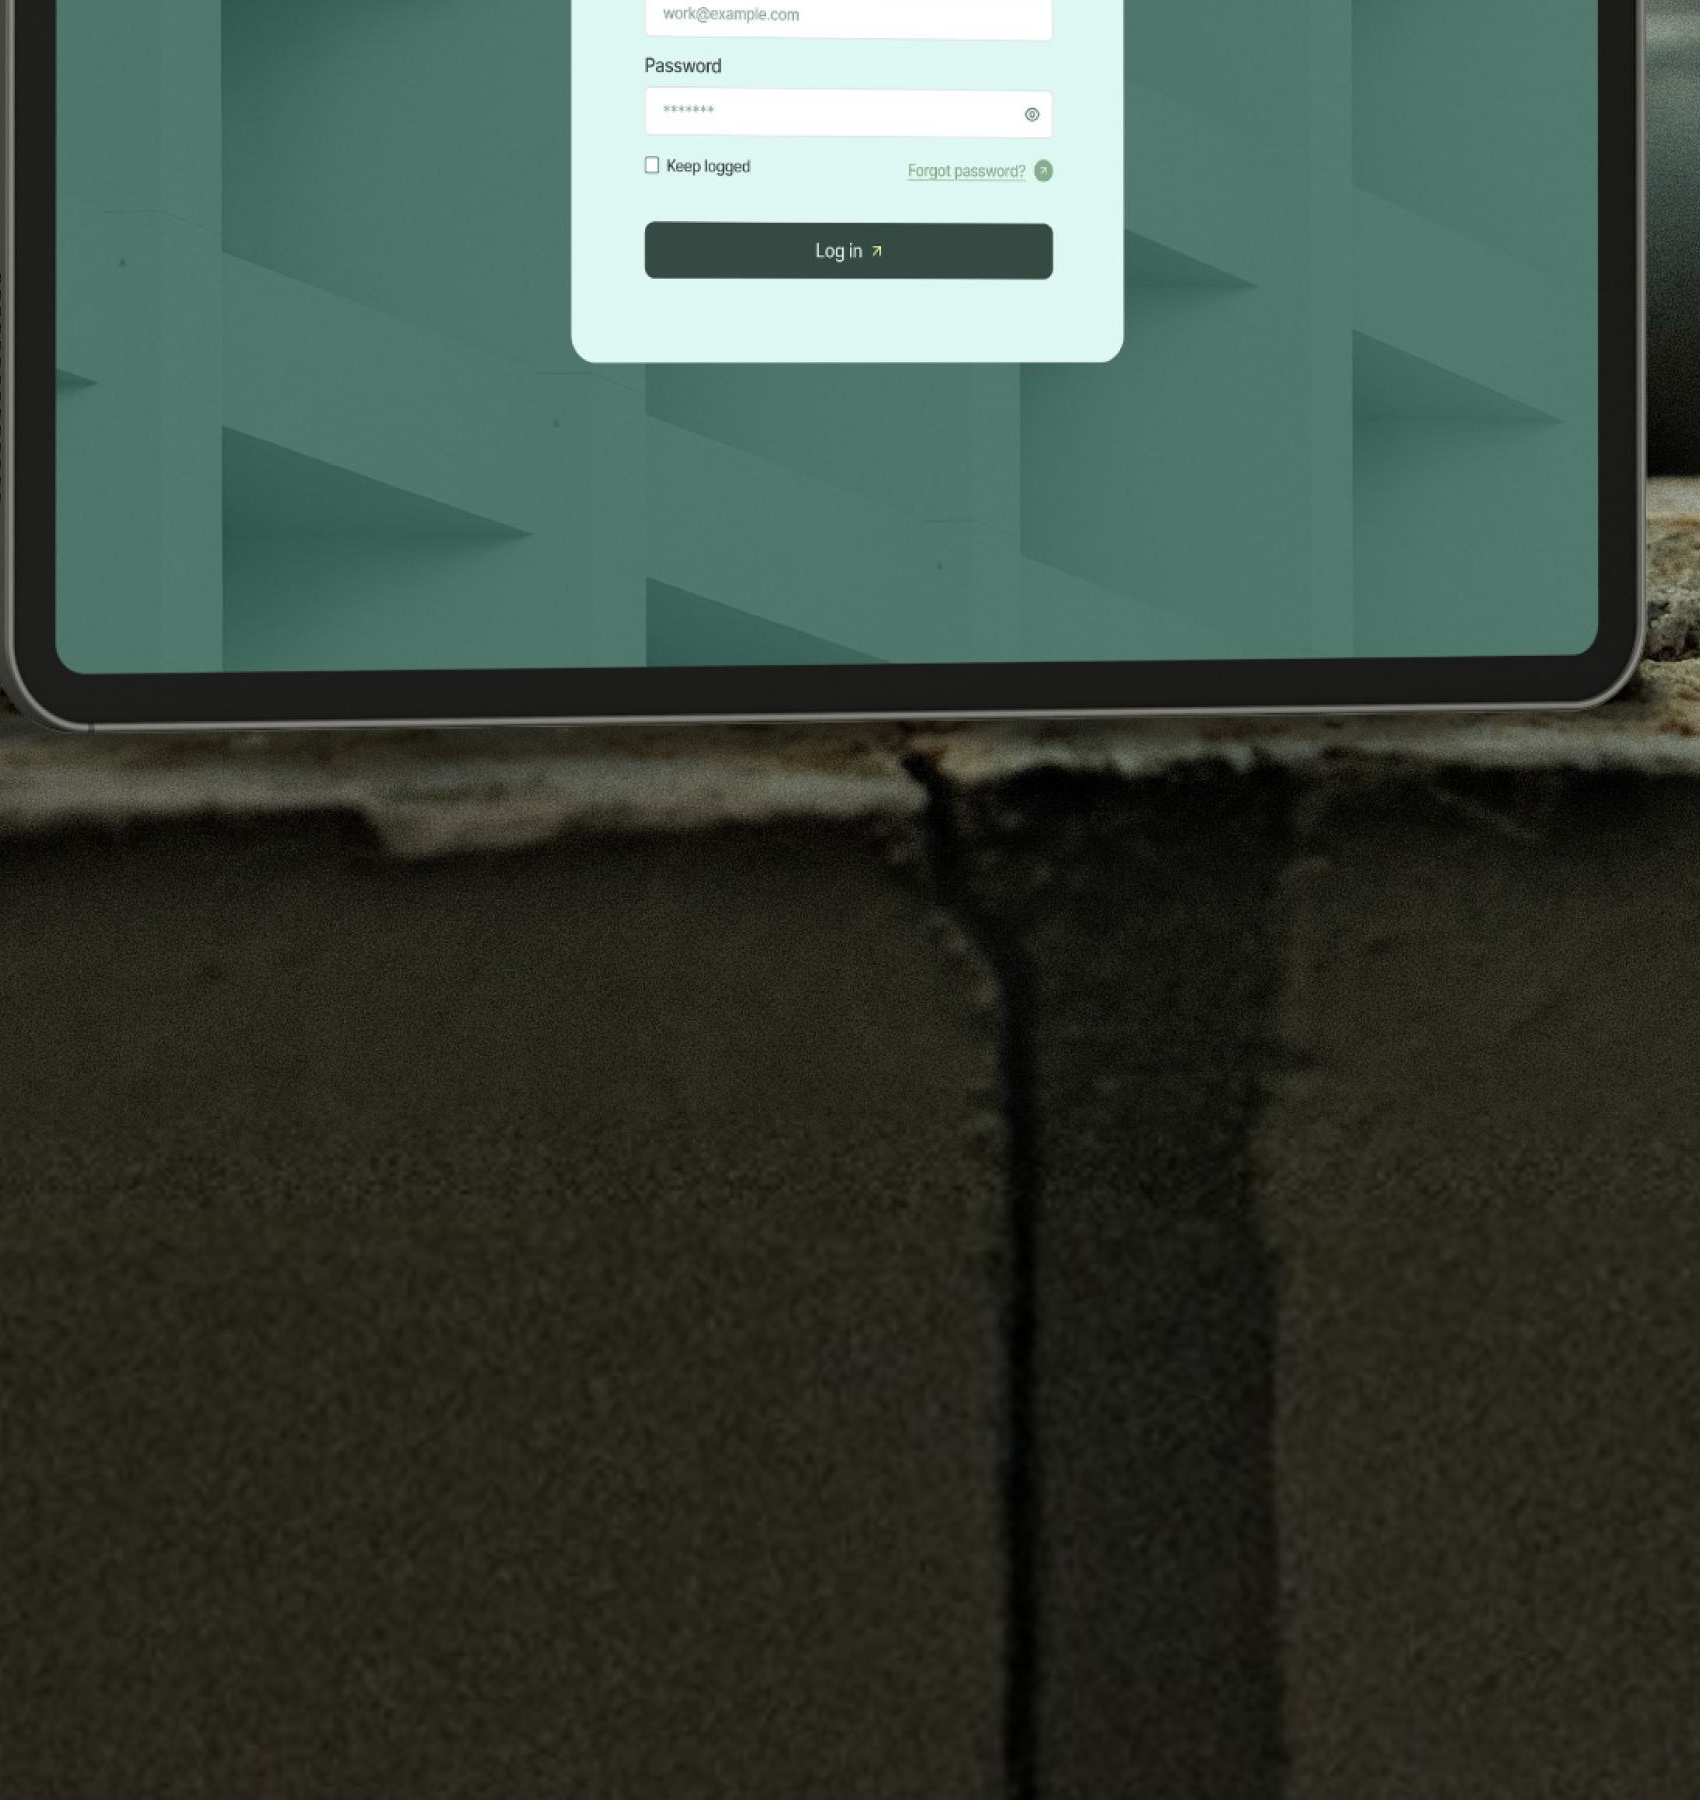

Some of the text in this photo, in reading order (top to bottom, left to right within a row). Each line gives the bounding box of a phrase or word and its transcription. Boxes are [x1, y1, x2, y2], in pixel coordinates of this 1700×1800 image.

[662, 6, 800, 24] work@example.com
[644, 57, 722, 74] Password
[666, 158, 751, 176] Keep logged
[907, 163, 1027, 181] Forgot password?
[815, 242, 863, 262] Log in
